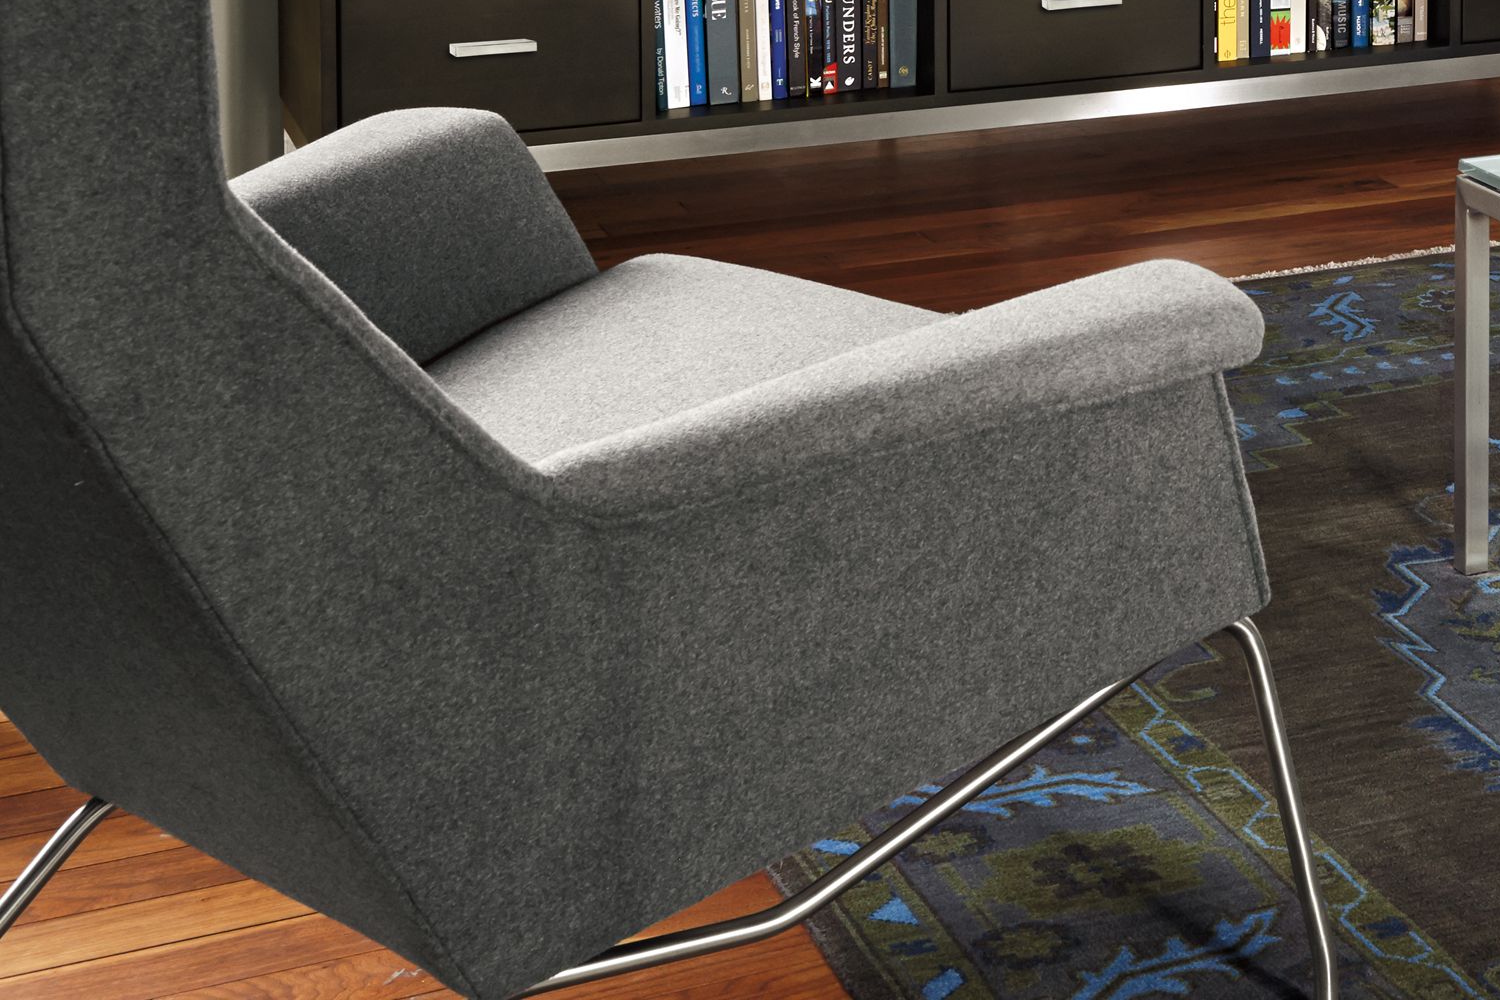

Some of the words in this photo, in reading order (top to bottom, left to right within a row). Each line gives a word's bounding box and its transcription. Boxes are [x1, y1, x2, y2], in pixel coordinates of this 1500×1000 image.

[654, 0, 662, 29] waters
[1337, 1, 1347, 33] MUSIC
[793, 43, 801, 58] Style
[657, 56, 665, 77] Donald
